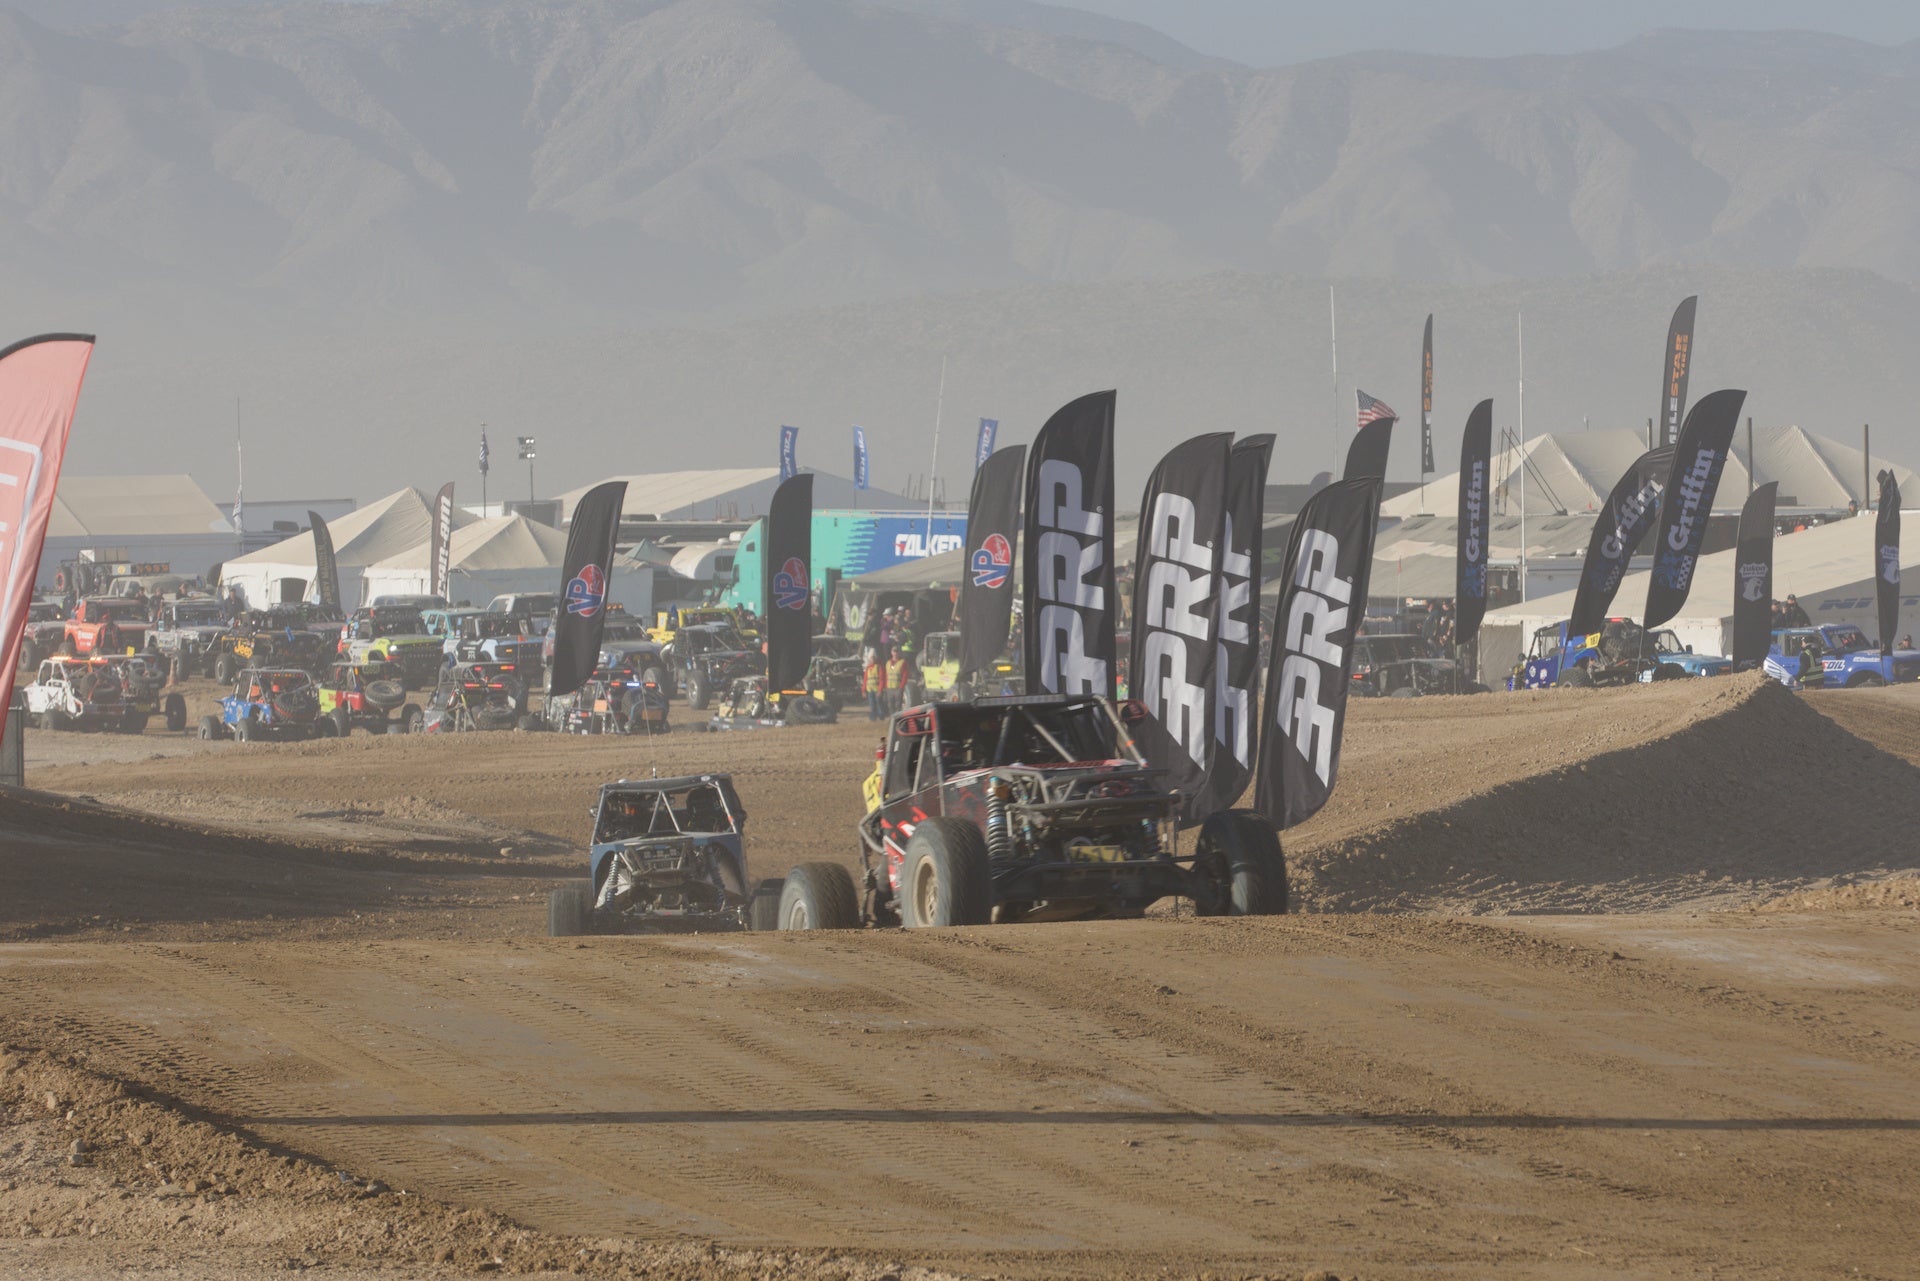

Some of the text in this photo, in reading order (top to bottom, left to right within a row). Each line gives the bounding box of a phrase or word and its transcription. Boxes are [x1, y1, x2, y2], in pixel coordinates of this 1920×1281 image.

[1465, 459, 1483, 562] Griffin
[1601, 479, 1664, 560] Griffin
[1668, 448, 1717, 551] Griffin
[895, 533, 962, 558] FALKEN
[971, 549, 1009, 588] VP
[1038, 459, 1107, 696] PRP
[565, 578, 601, 613] VP
[773, 571, 804, 608] VP
[234, 640, 253, 659] Jeep
[1143, 493, 1212, 770] PRP
[1277, 528, 1352, 788] PRP
